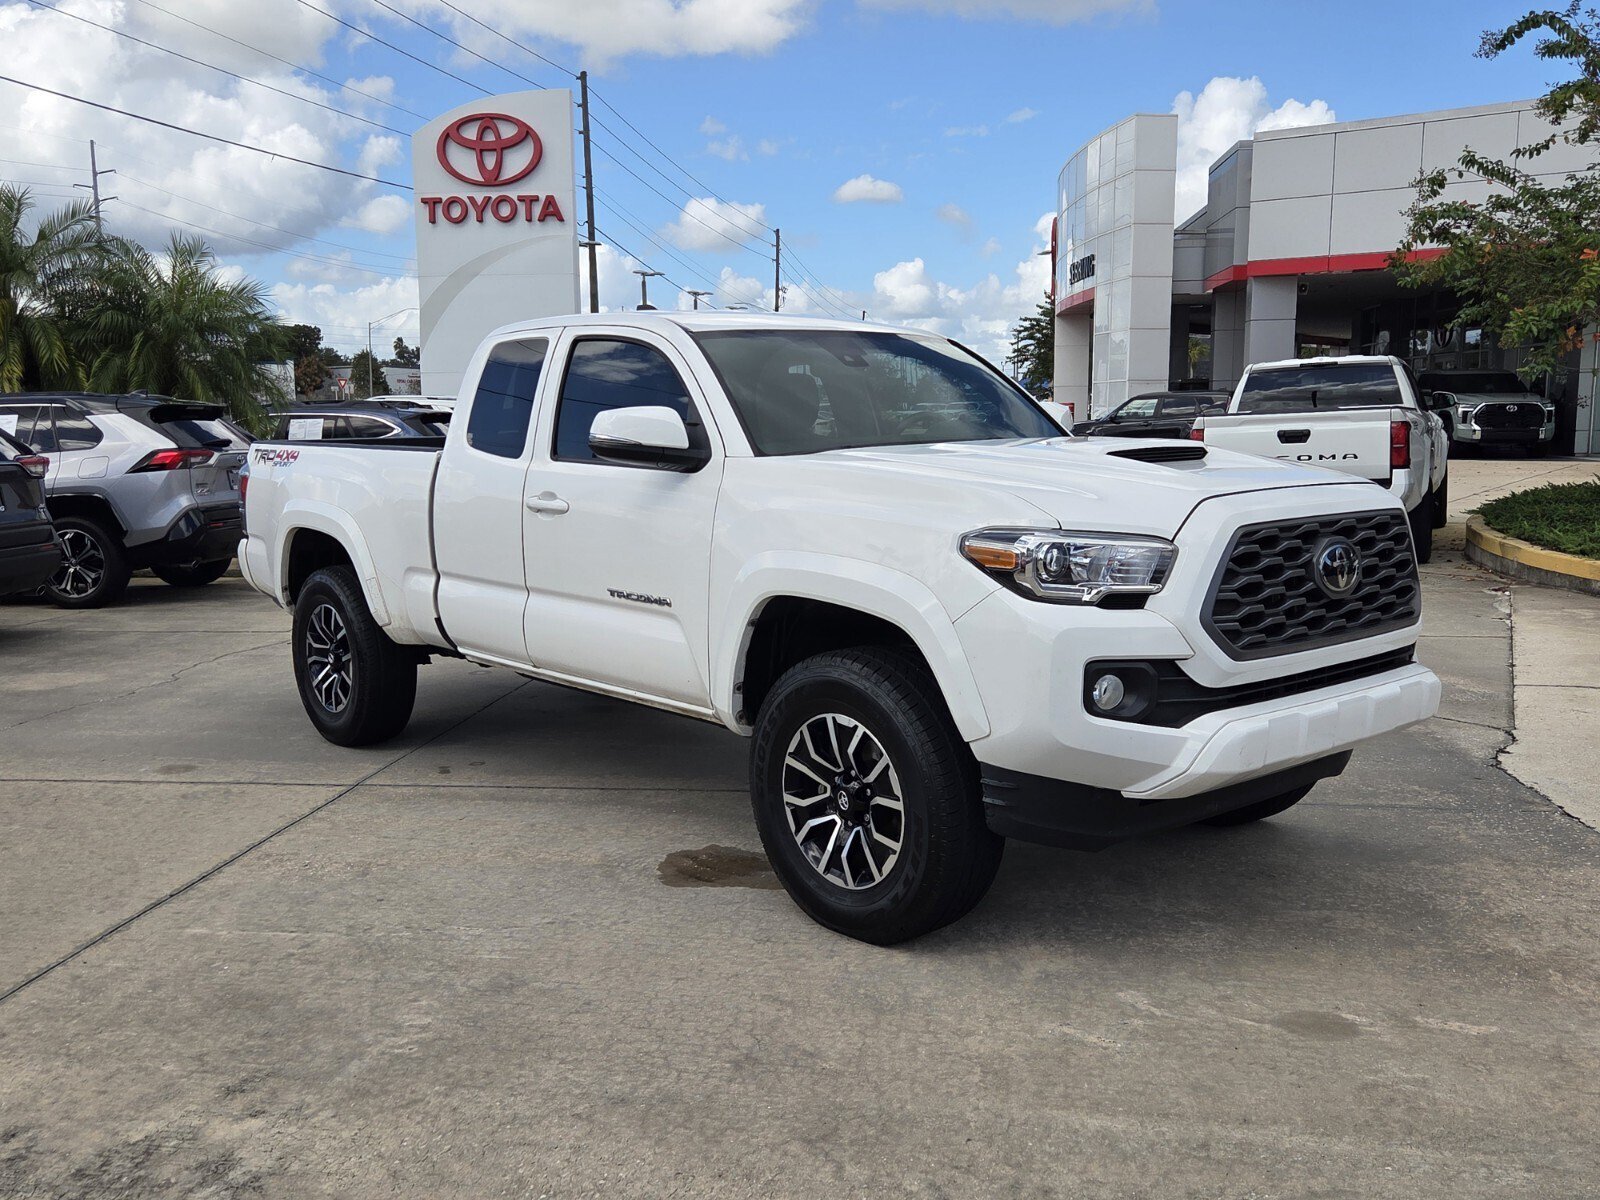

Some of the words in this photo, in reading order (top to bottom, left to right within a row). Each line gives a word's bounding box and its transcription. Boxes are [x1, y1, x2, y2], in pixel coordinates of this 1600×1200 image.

[421, 195, 565, 224] TOYOTA
[1276, 453, 1359, 462] OMA
[606, 588, 672, 607] TACOMA
